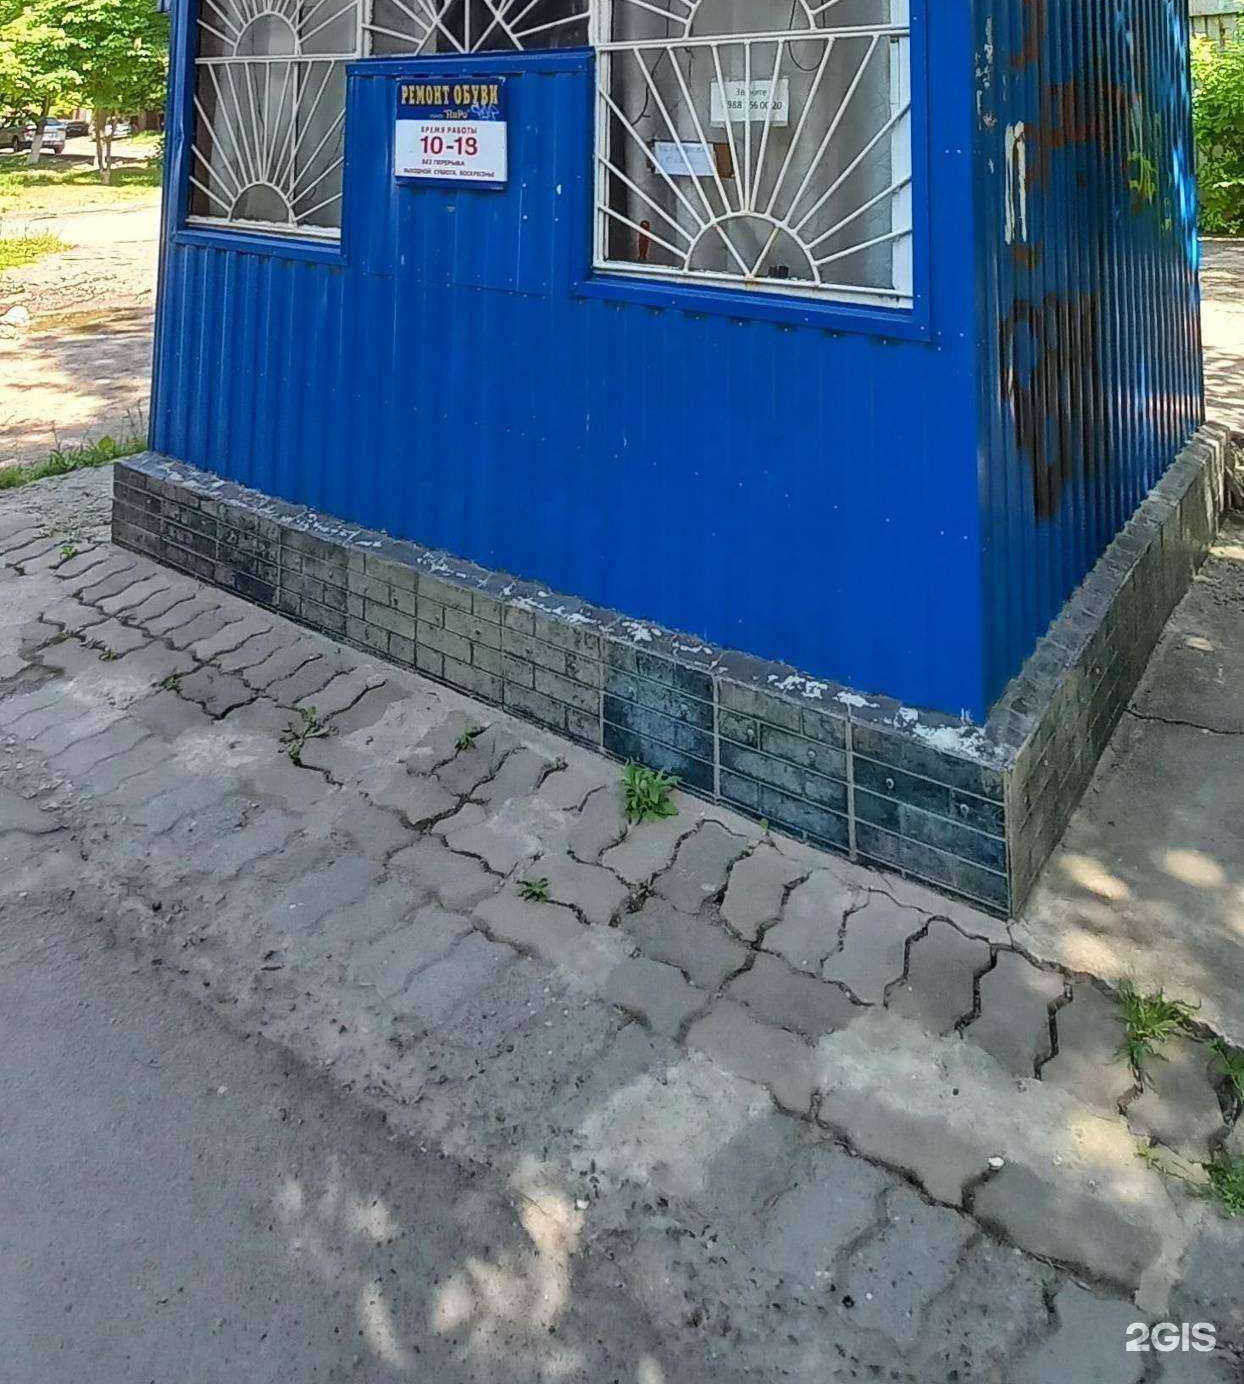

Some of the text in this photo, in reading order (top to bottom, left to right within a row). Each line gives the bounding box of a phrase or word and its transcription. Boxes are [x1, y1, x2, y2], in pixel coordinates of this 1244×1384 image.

[401, 84, 499, 106] РЕМОНТ ОБУВИ
[421, 126, 478, 135] ВРЕМЯ РАБОТЫ
